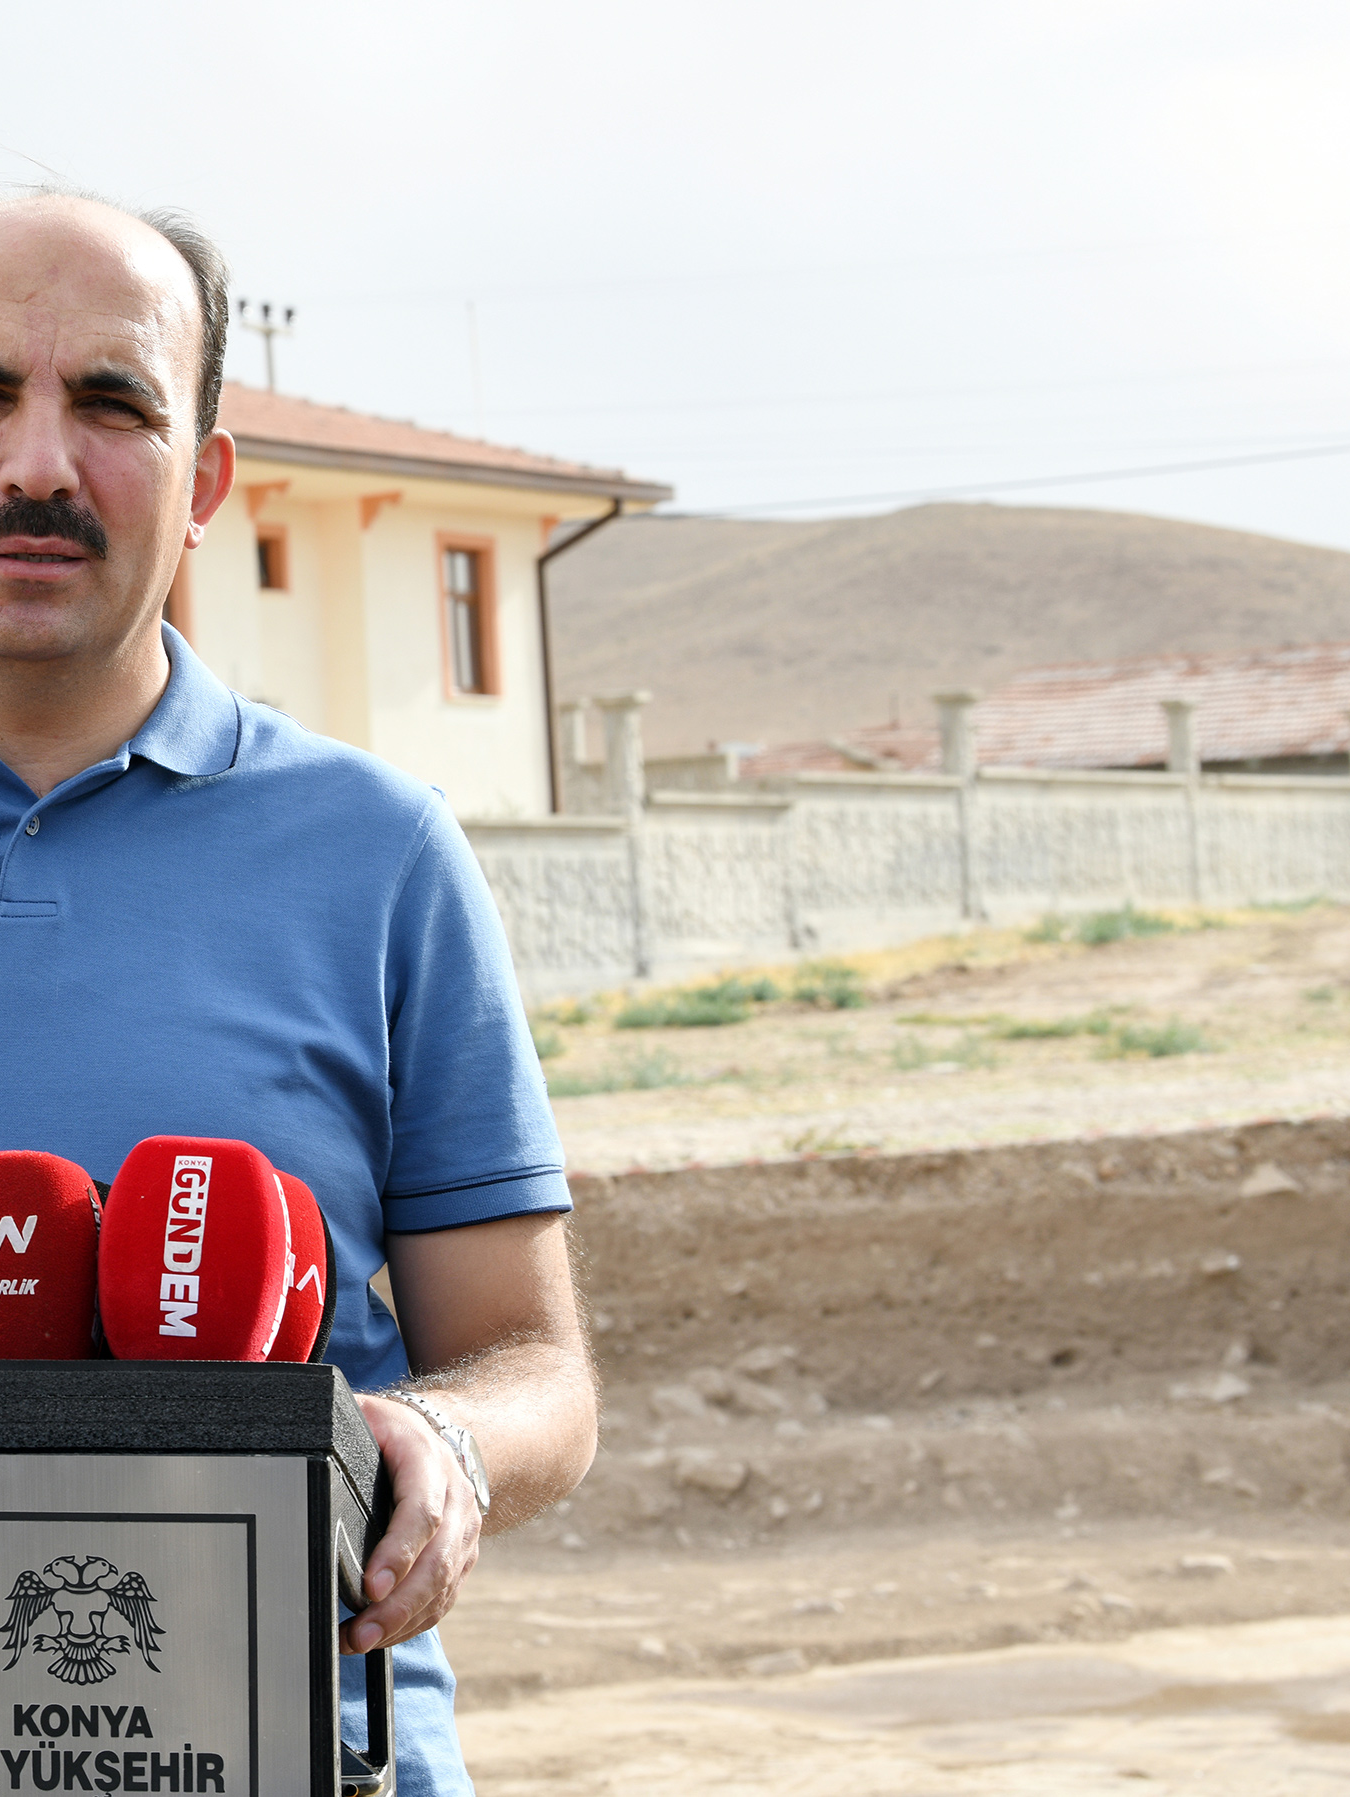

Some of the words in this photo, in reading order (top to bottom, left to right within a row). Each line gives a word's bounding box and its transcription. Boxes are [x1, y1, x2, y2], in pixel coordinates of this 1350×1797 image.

[178, 1159, 208, 1167] KONYA
[158, 1167, 208, 1338] GÜNDEM
[13, 1703, 154, 1739] KONYA
